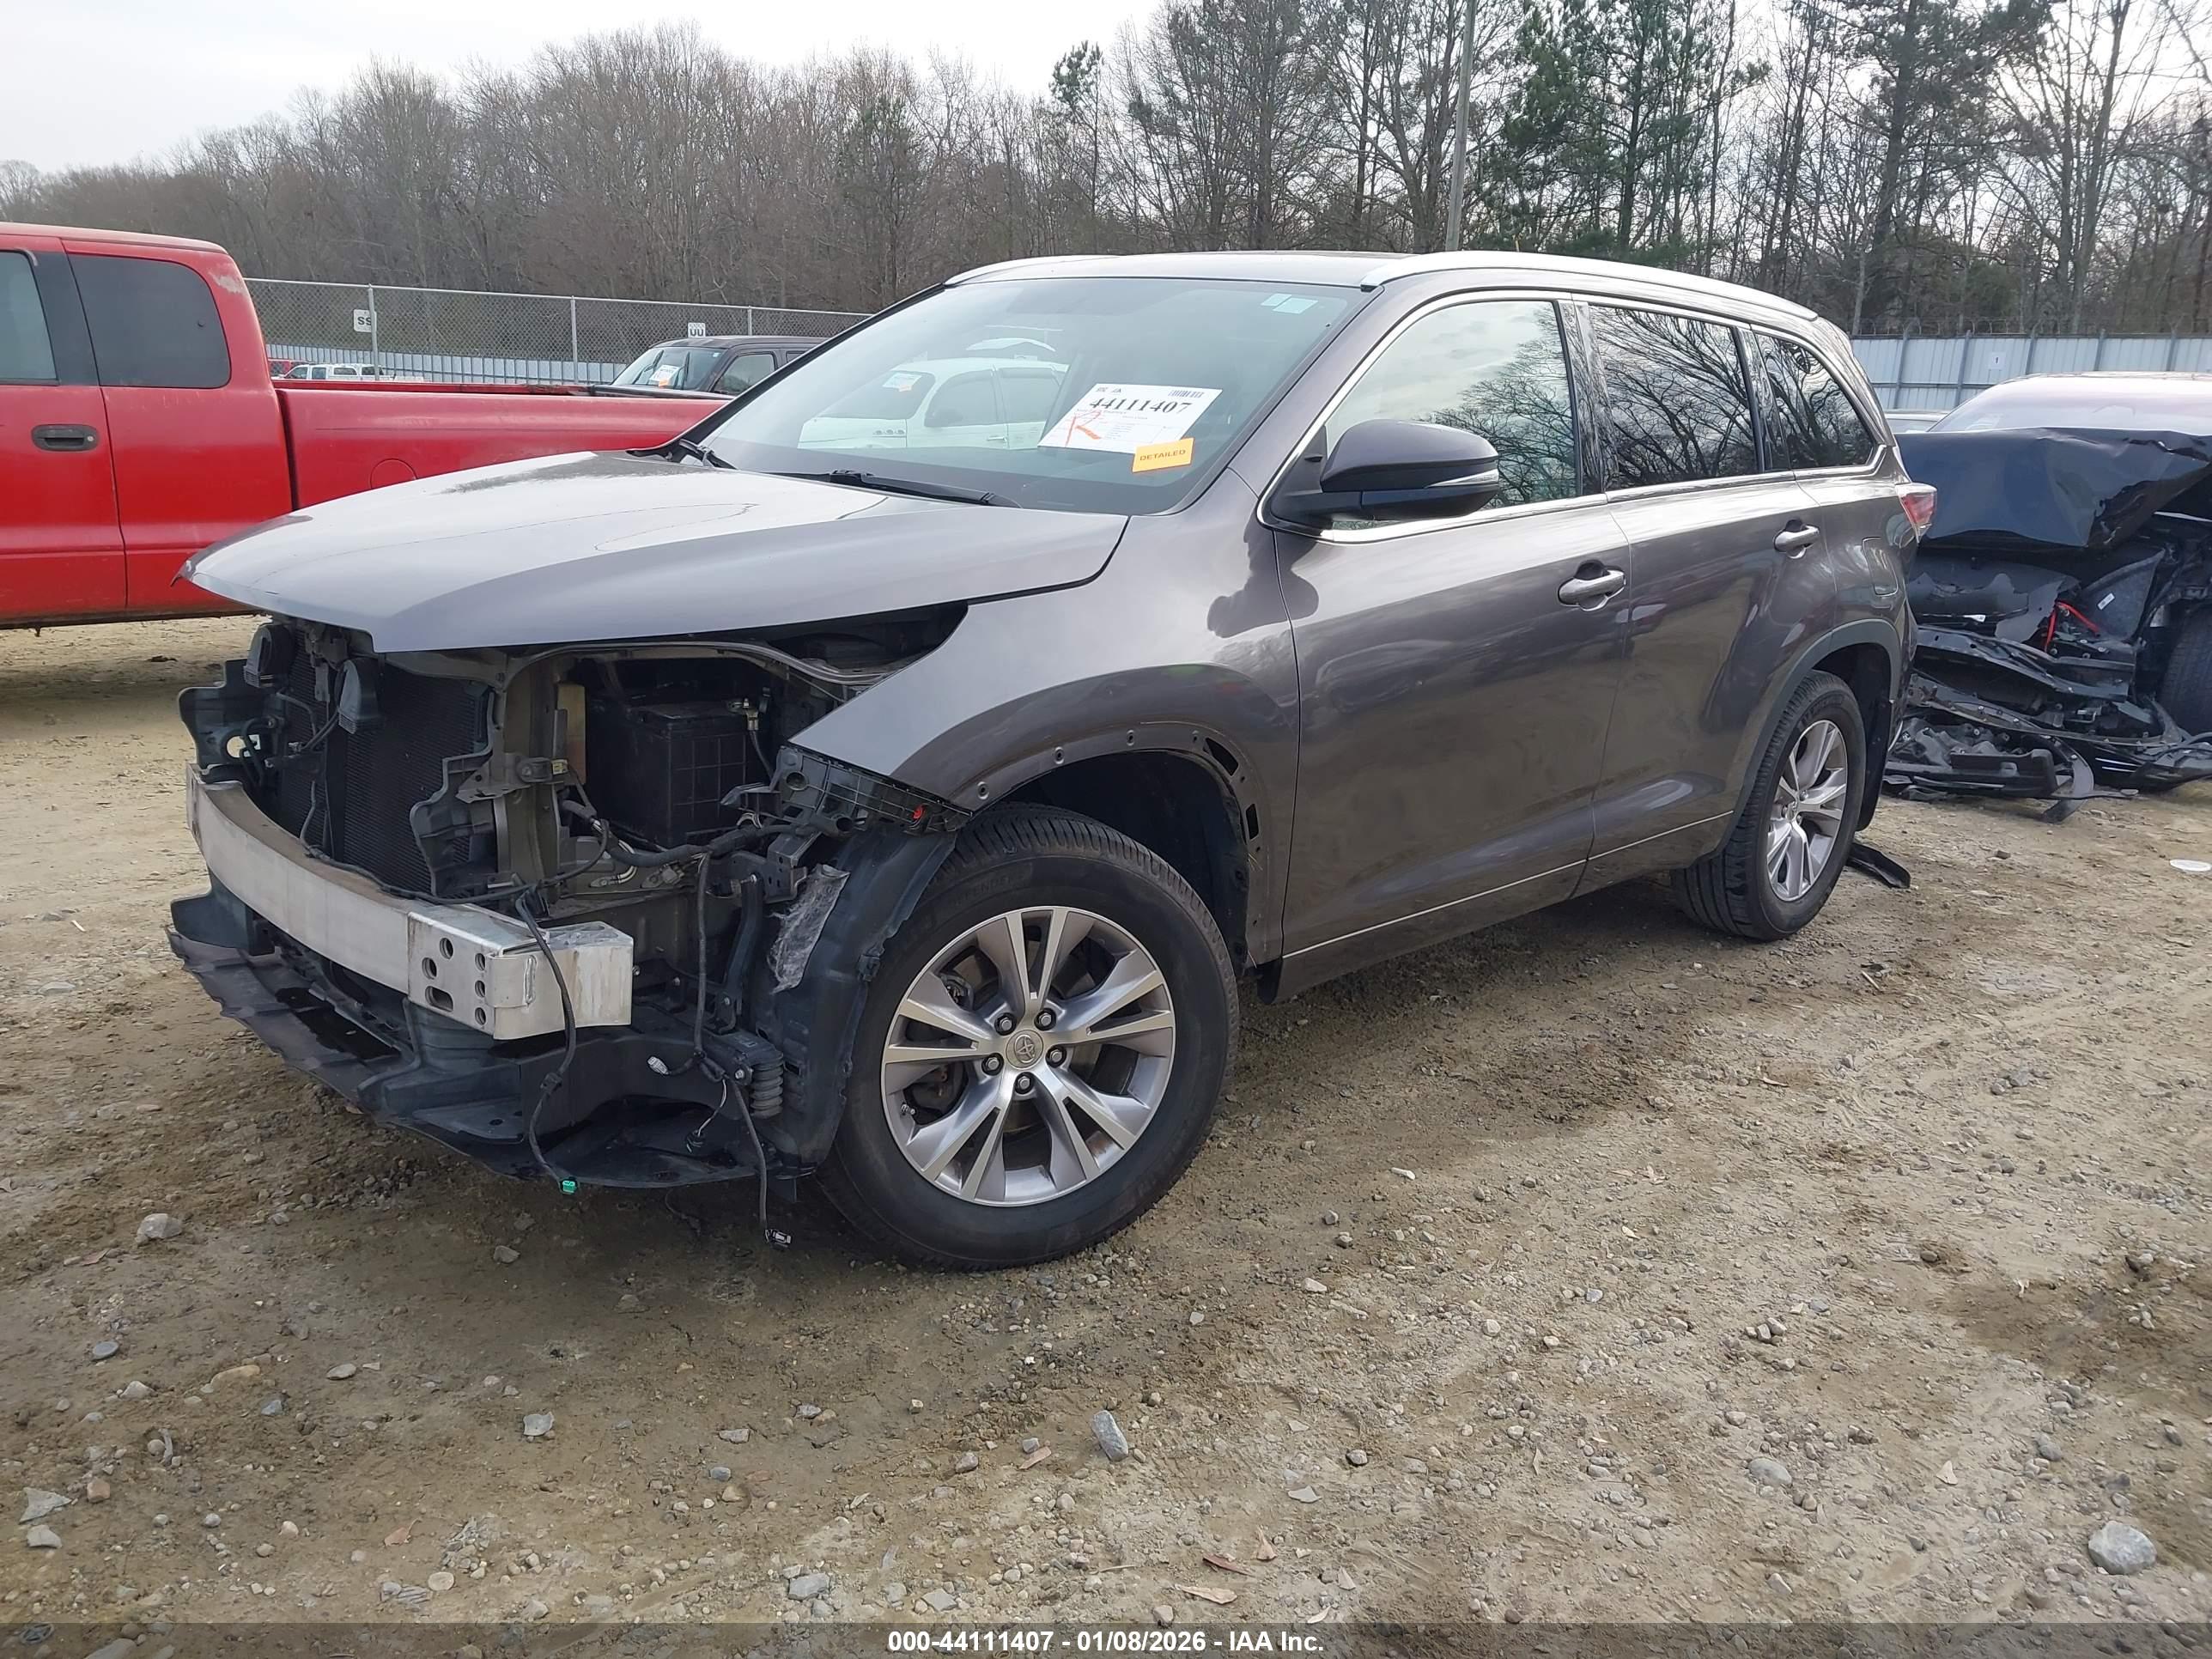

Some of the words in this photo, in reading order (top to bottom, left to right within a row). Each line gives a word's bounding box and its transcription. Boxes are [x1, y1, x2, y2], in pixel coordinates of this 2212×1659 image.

[357, 316, 372, 325] SS
[690, 328, 704, 337] UU
[1090, 398, 1193, 414] 44111407
[1139, 449, 1186, 461] DETAILED
